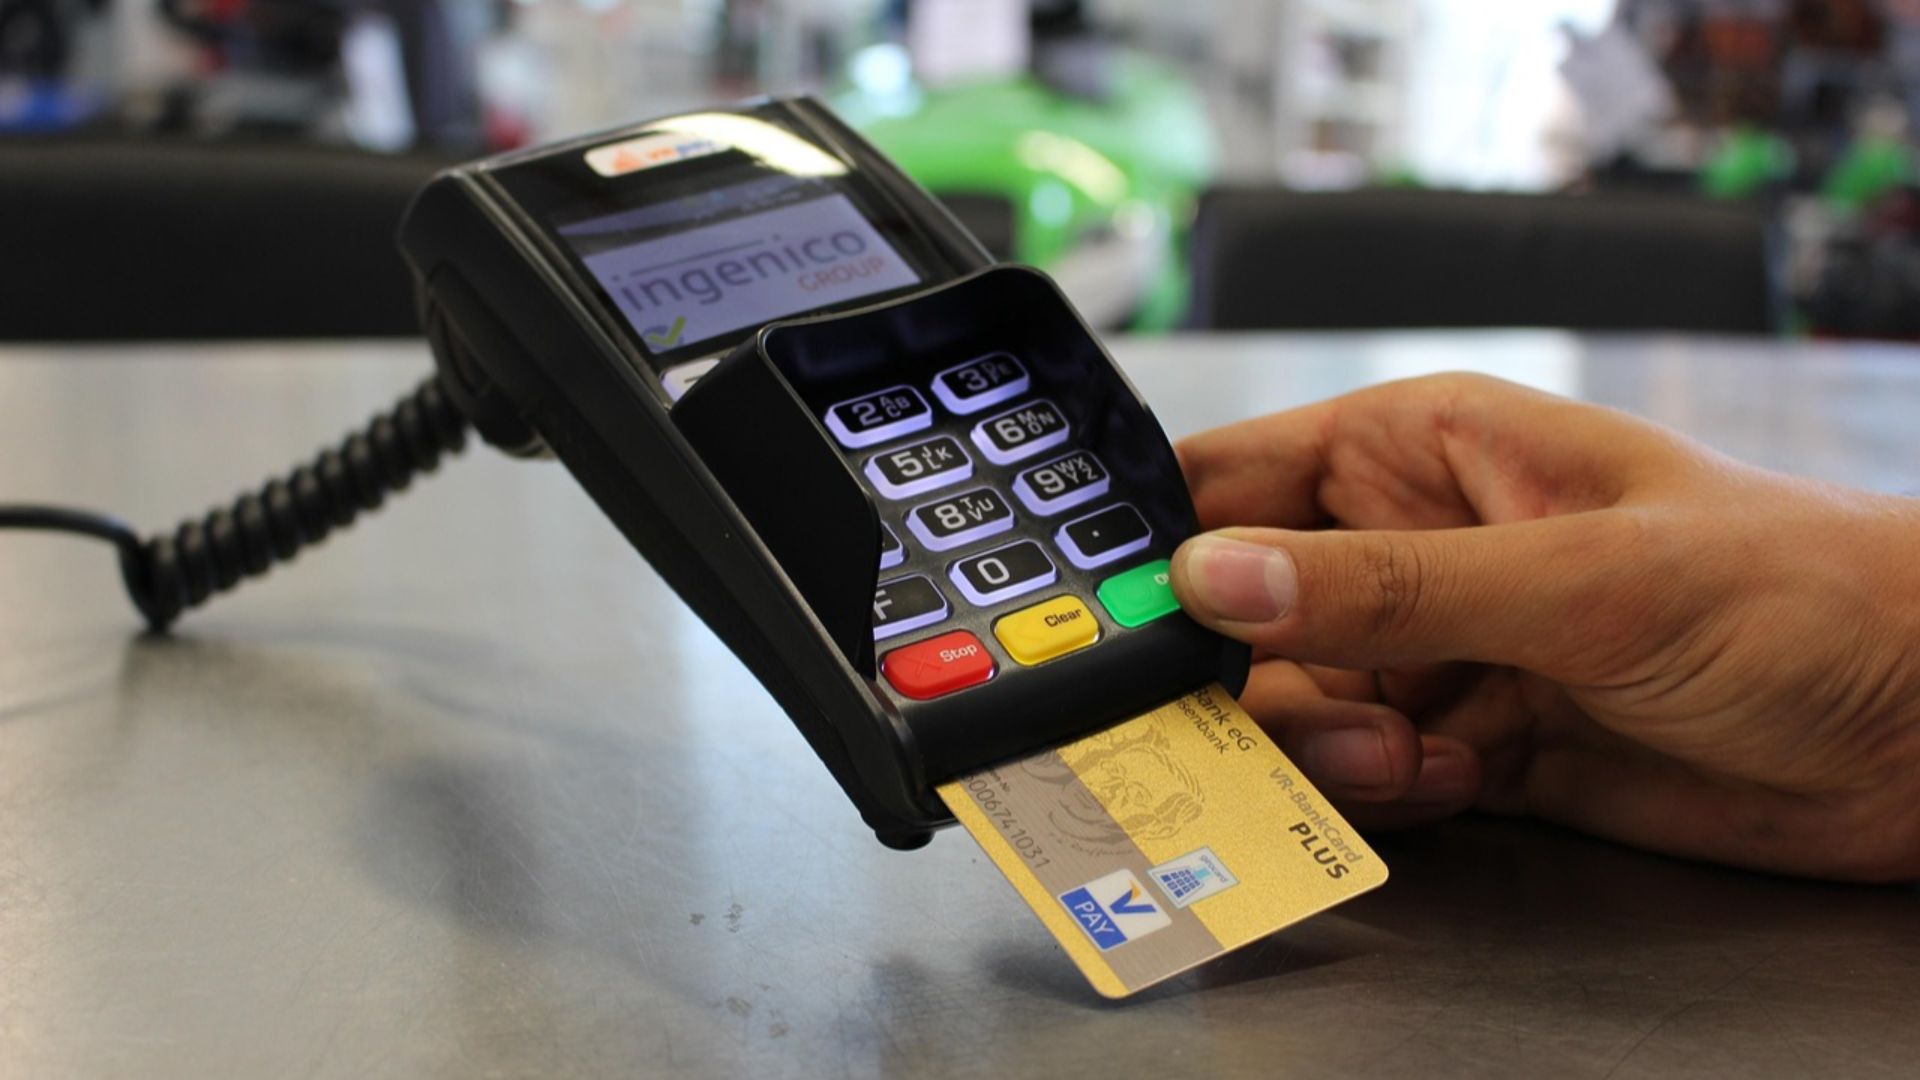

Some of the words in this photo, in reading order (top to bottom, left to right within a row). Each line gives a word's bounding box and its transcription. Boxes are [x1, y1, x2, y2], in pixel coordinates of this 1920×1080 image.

[610, 229, 868, 312] ingenico
[797, 255, 889, 292] GROUP
[958, 367, 989, 391] 3
[851, 401, 884, 427] 2
[995, 418, 1026, 443] 6
[891, 451, 924, 477] 5
[1033, 469, 1065, 494] 9
[934, 503, 966, 530] 8
[1043, 607, 1083, 629] Clear
[939, 642, 978, 663] Stop
[1227, 727, 1258, 752] eG
[967, 774, 1051, 868] 006741031
[1269, 766, 1364, 863] VR-BankCard
[1287, 821, 1350, 879] PLUS
[1073, 900, 1116, 934] PAY
